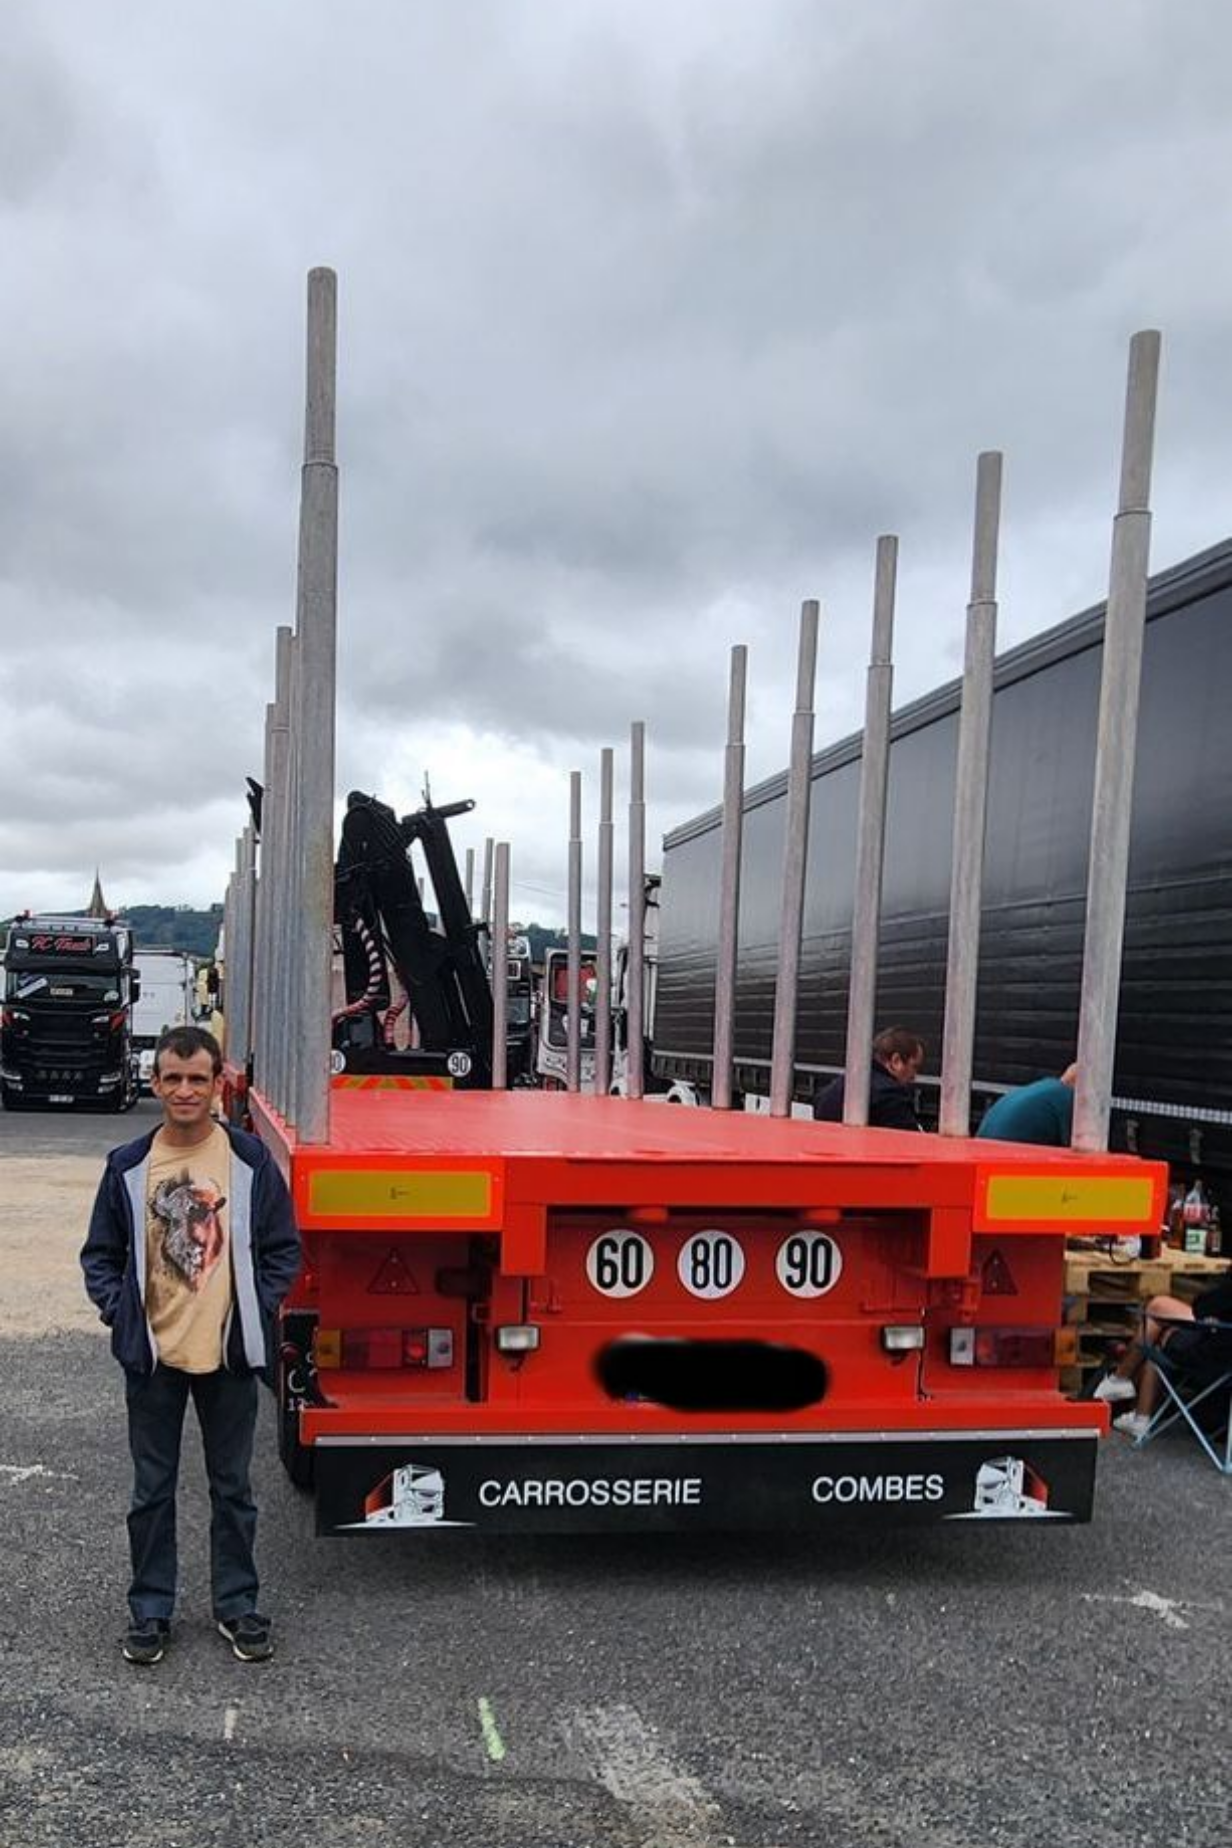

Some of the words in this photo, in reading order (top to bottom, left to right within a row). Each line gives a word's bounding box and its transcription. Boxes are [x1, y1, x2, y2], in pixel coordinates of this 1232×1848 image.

[452, 1055, 468, 1073] 90
[596, 1237, 644, 1289] 60
[691, 1238, 733, 1289] 80
[786, 1237, 833, 1289] 90
[479, 1478, 702, 1507] CARROSSERIE
[812, 1474, 944, 1502] COMBES
